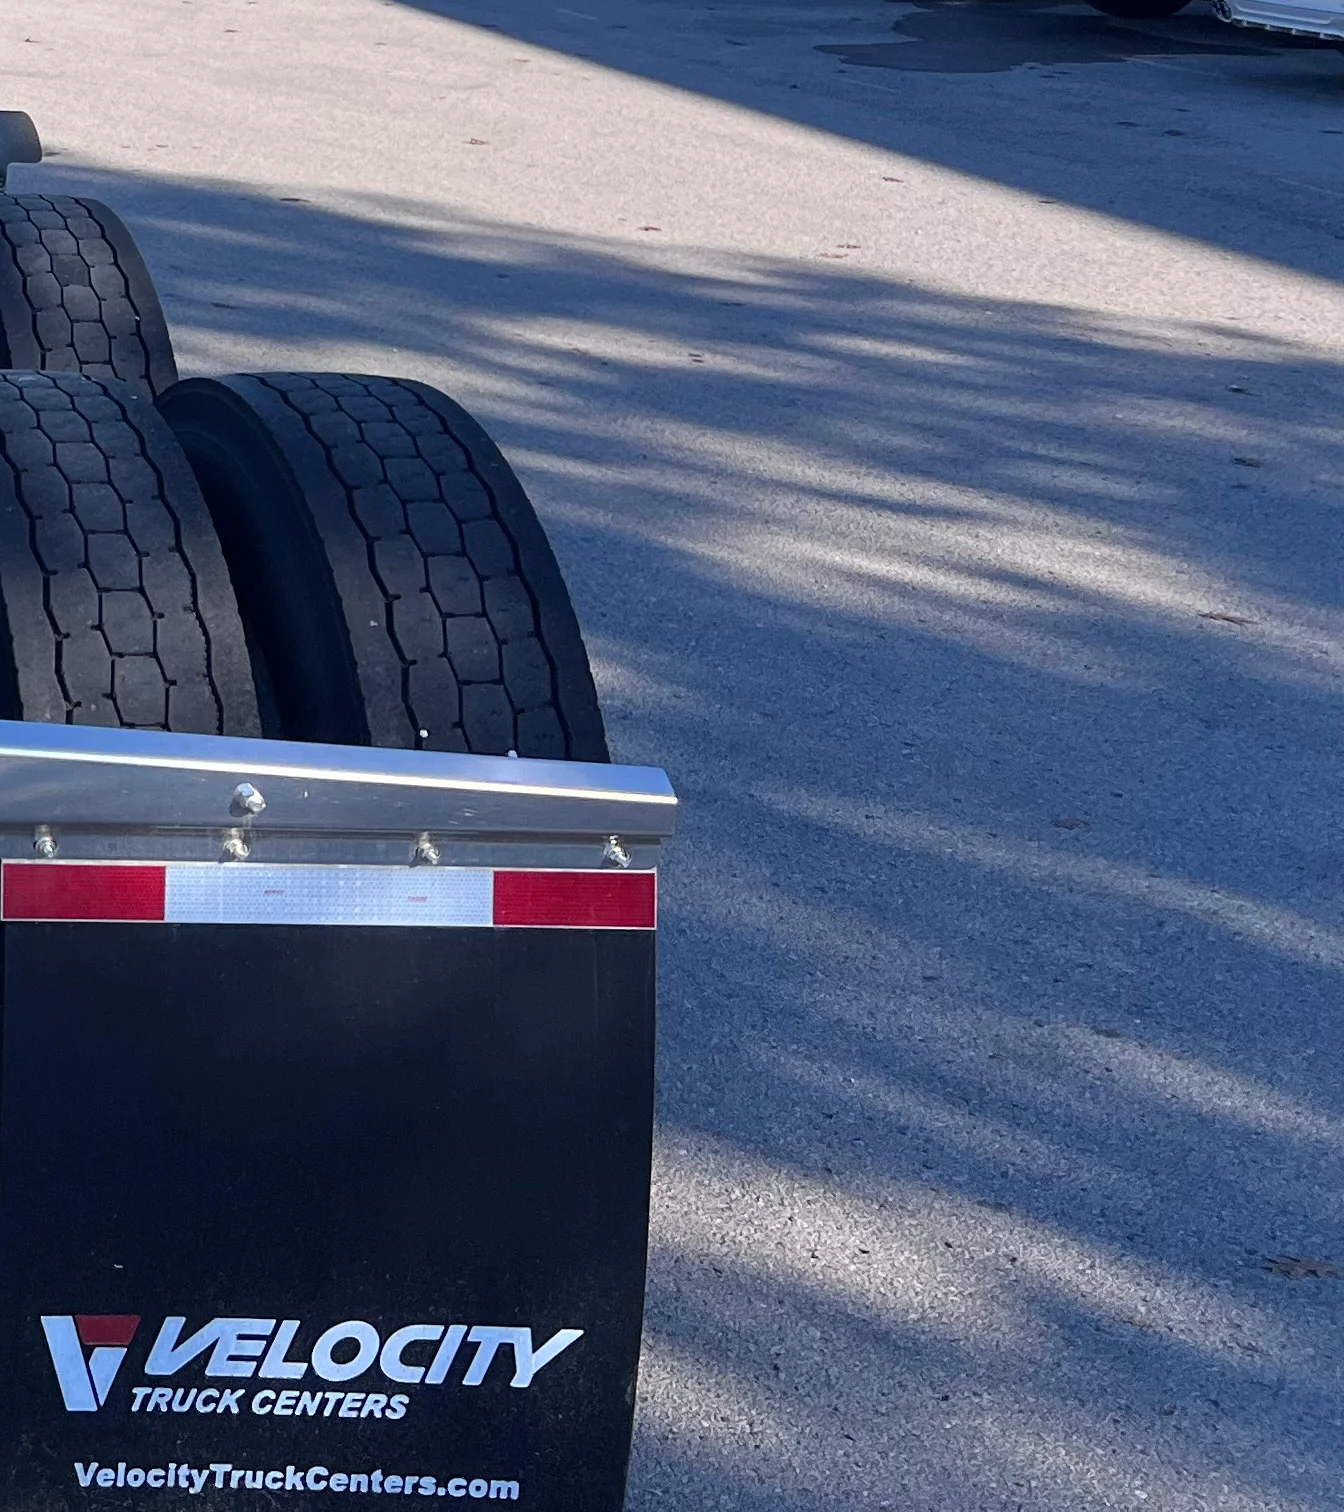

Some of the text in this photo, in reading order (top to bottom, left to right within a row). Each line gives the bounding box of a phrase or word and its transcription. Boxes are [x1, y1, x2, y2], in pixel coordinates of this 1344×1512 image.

[144, 1316, 584, 1388] VELOCITY
[130, 1387, 410, 1420] TRUCK CENTERS
[74, 1462, 520, 1500] VelocityTruckCenters.com
